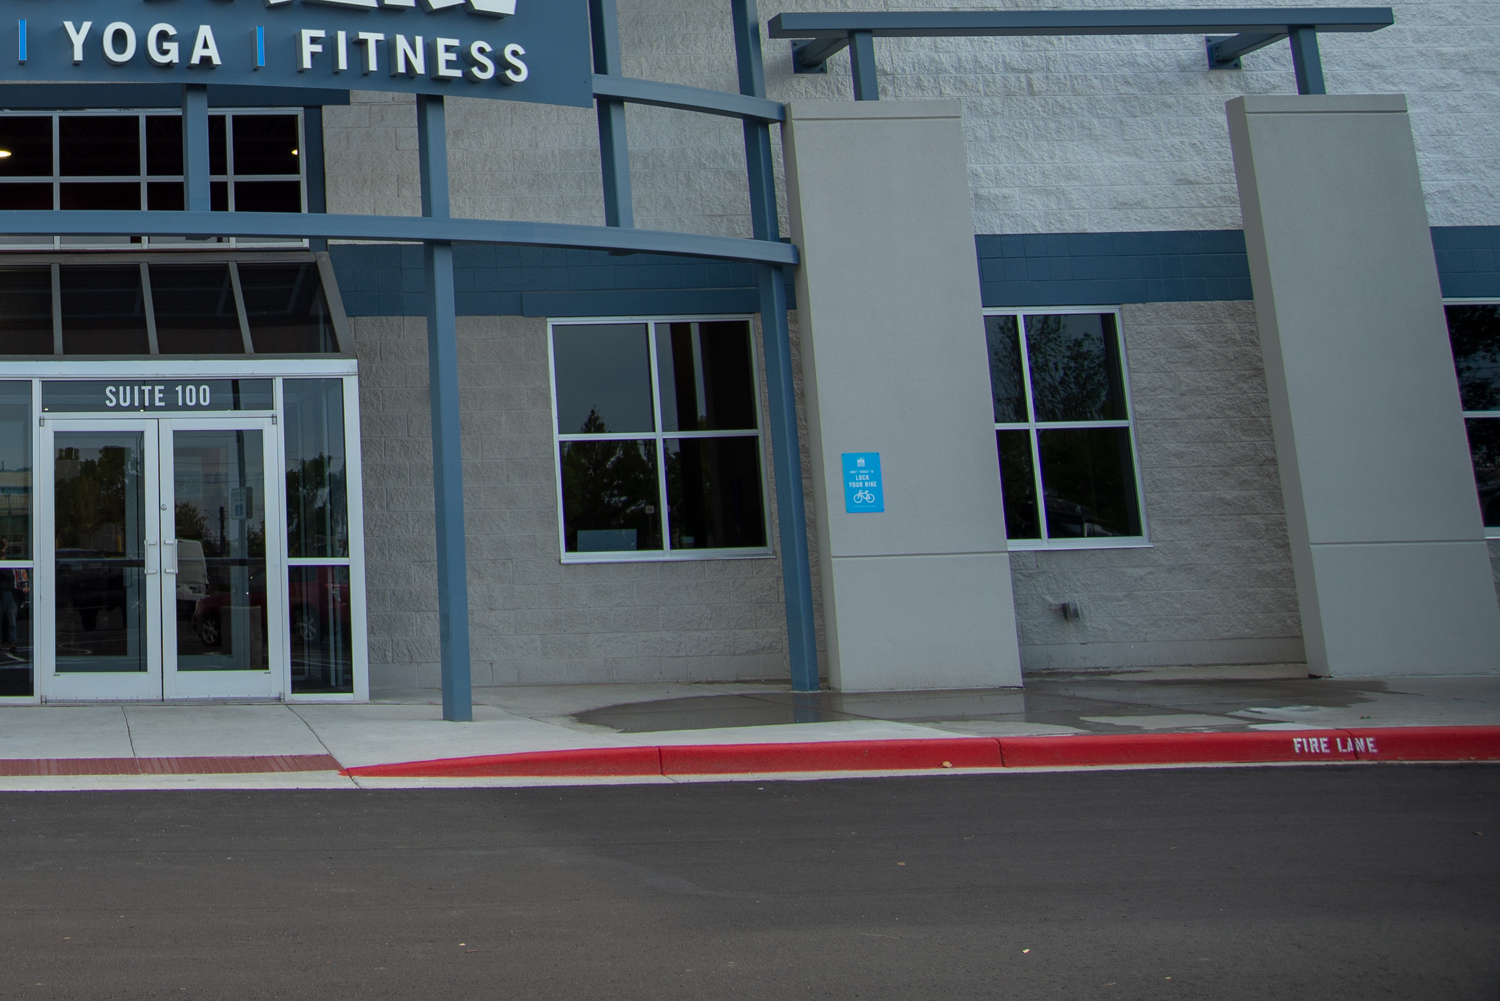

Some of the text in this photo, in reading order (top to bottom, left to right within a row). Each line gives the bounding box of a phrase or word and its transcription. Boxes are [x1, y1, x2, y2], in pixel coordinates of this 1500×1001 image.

[63, 20, 222, 67] YOGA
[298, 28, 528, 83] FITNESS
[105, 384, 211, 407] SUITE 100
[1292, 737, 1378, 753] FIRE LANE
